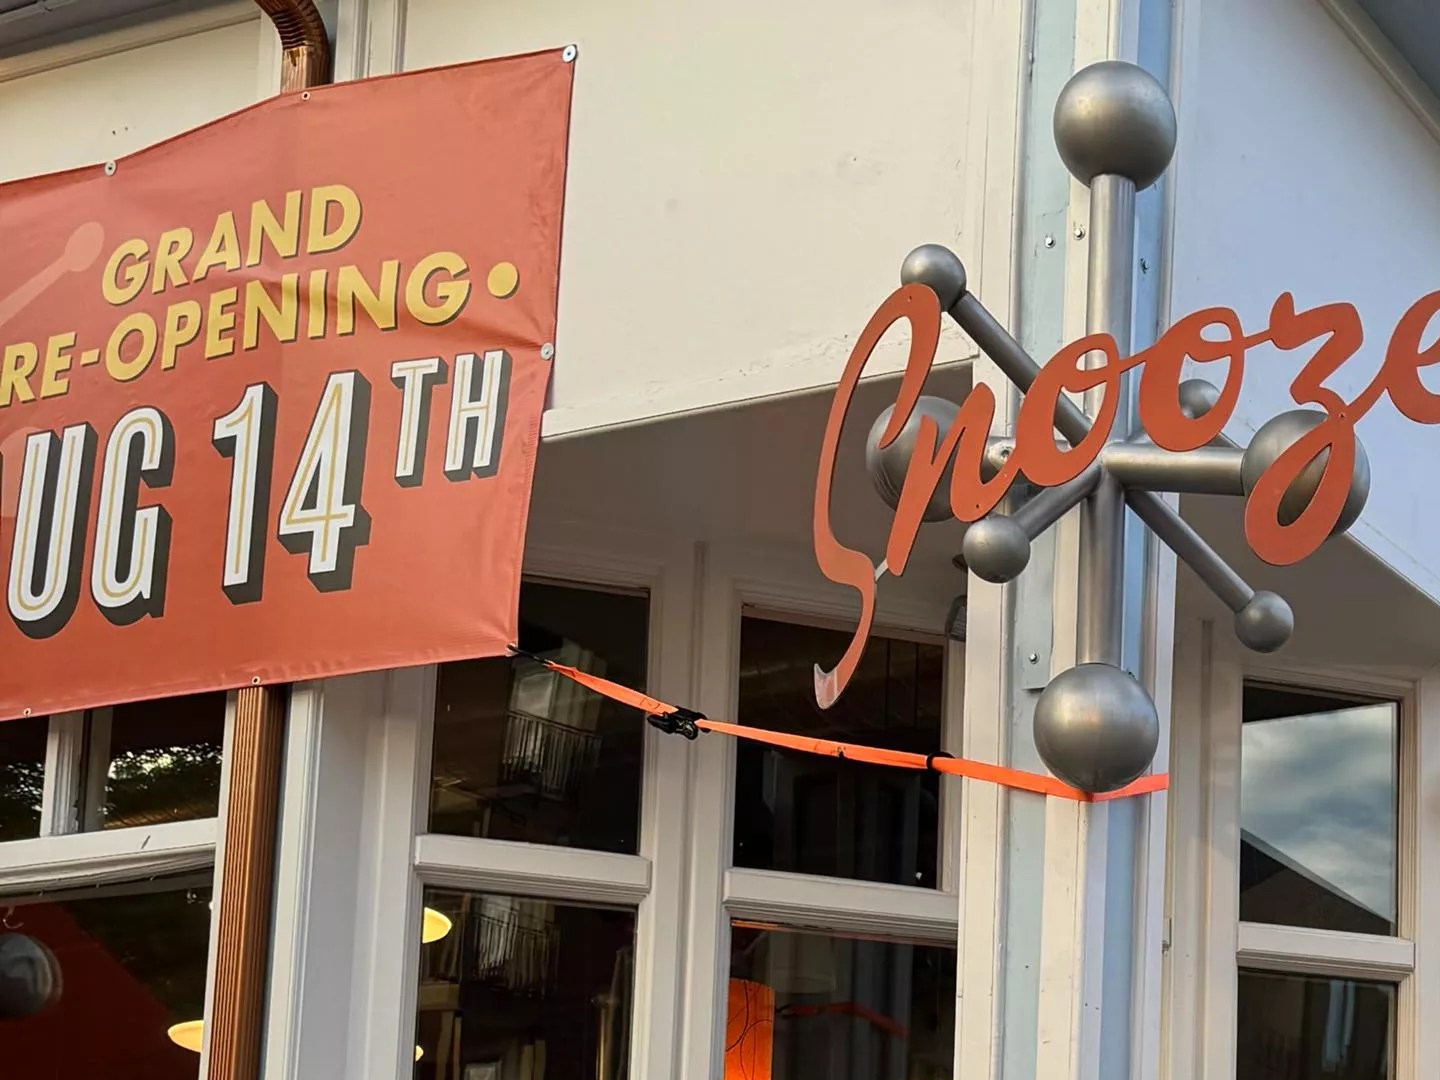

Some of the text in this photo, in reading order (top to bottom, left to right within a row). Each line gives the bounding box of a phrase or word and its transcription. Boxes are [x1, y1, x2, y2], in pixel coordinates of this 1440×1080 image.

[101, 184, 362, 306] GRAND
[0, 251, 471, 402] RE-OPENING
[2, 407, 174, 639] UG
